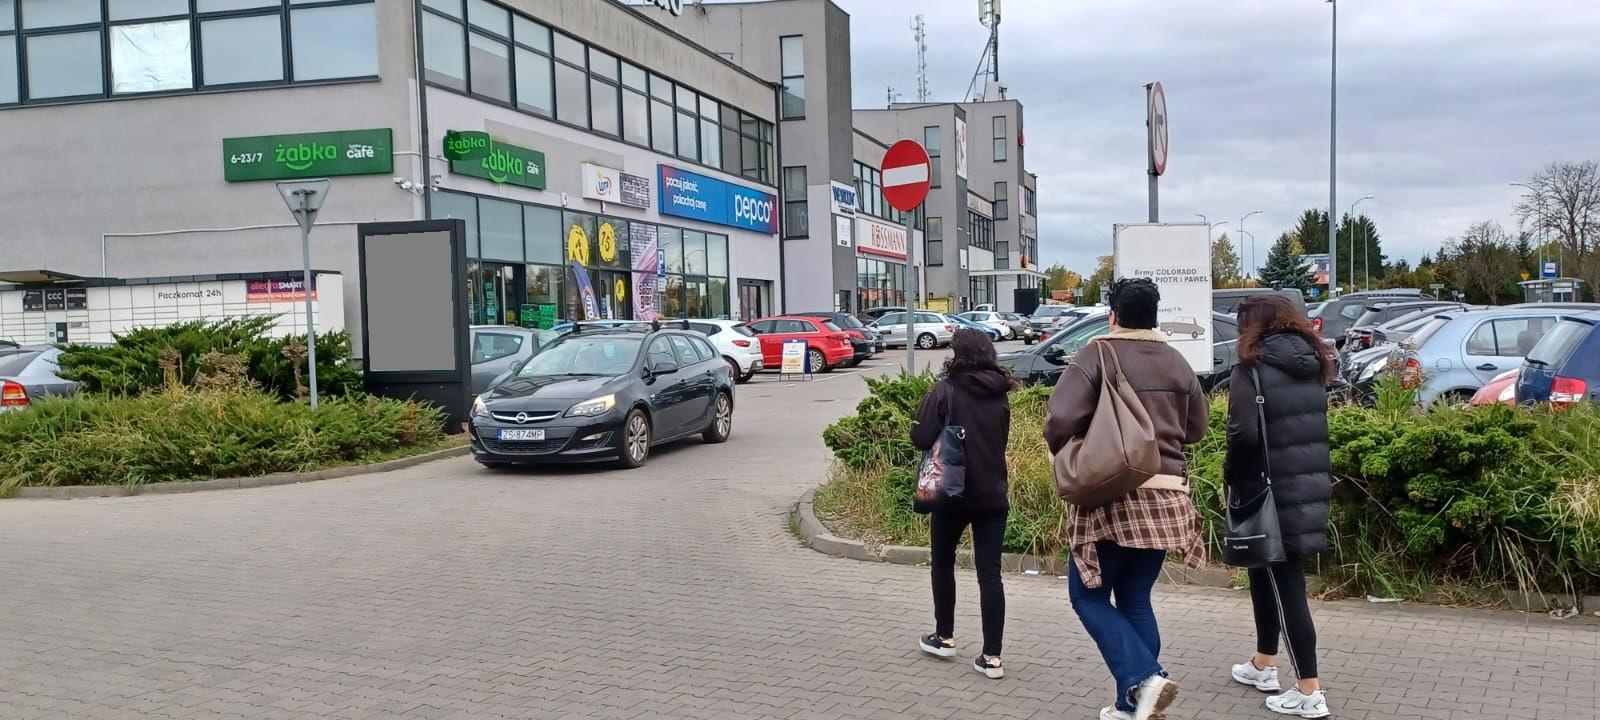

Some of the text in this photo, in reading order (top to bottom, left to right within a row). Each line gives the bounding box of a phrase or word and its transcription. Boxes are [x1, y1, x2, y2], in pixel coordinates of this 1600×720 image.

[448, 137, 486, 150] żabka
[231, 152, 263, 164] 6-23/7
[275, 142, 337, 162] żabka
[735, 194, 770, 225] pepco
[1156, 268, 1197, 276] COLORADO
[158, 289, 222, 300] Paczkomat 24h
